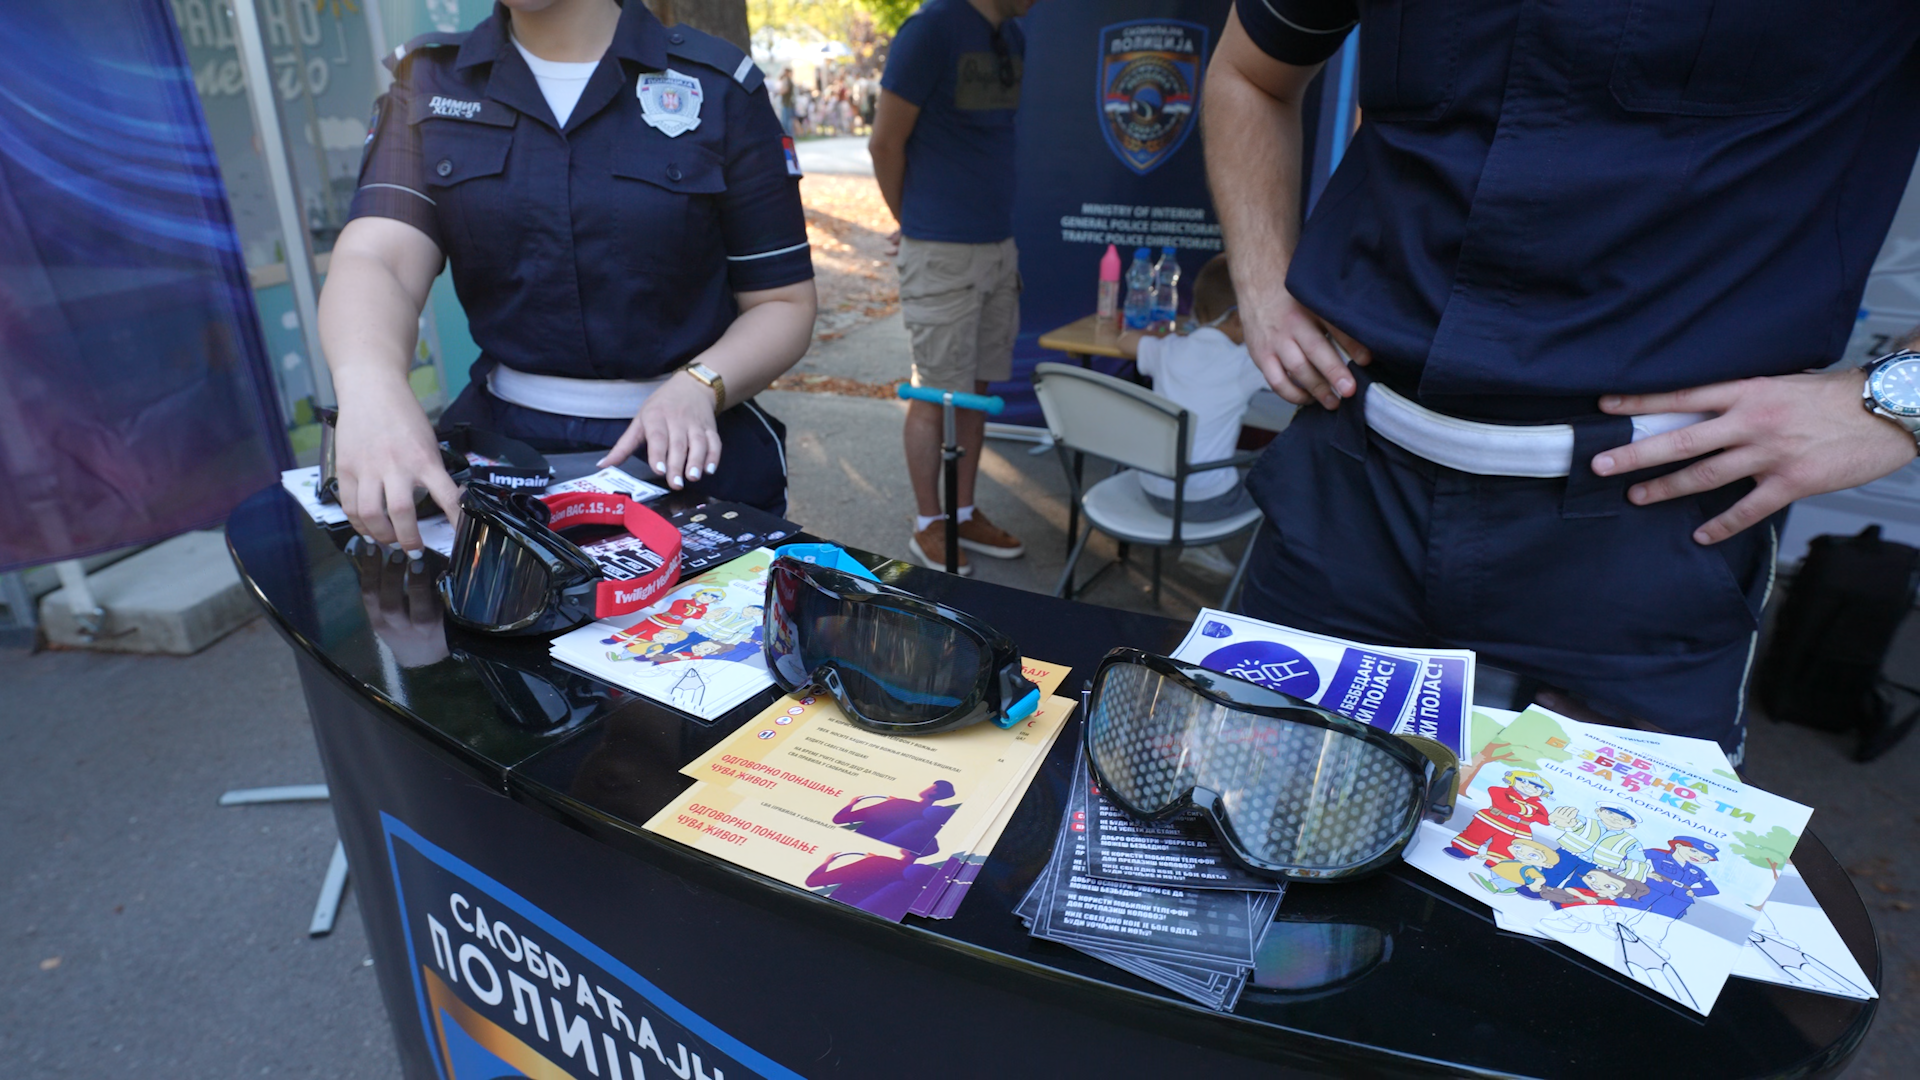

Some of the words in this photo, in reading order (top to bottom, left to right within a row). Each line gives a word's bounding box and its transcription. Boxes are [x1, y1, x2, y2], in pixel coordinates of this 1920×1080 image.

[1110, 37, 1194, 53] ПОЛИЦИЈА
[1081, 203, 1133, 217] MINISTRY
[1133, 205, 1150, 218] OF
[1151, 207, 1206, 221] INTERIOR
[1060, 215, 1108, 231] GENERAL
[1109, 218, 1149, 233] POLICE
[1061, 229, 1104, 243] TRAFFIC
[1105, 232, 1144, 247] POLICE
[1145, 235, 1222, 251] DIRECTORATE
[566, 503, 584, 518] BAC
[614, 580, 656, 604] Twilight
[1340, 654, 1377, 711] БЕЗБЕДАН!
[1361, 660, 1397, 710] ПОЈАС!
[1420, 663, 1444, 719] ПОЈАС!
[830, 731, 849, 740] НОСИТЕ
[849, 737, 868, 746] КАЦИГУ
[798, 754, 821, 765] ПРАВИЛА
[801, 748, 819, 757] ВРЕМЕ
[1583, 733, 1617, 748] ЗАЈЕДНО
[1624, 748, 1665, 766] БЕЗБЕДНО
[1665, 763, 1686, 774] КРОЗ
[1686, 771, 1739, 794] ДЕТИЊСТВО
[711, 763, 735, 777] ЧУВА
[735, 771, 778, 790] ЖИВОТ!
[721, 754, 781, 777] ОДГОВОРНО
[780, 770, 844, 798] ПОНАШАЊЕ
[1577, 760, 1613, 782] ЗА
[1544, 762, 1573, 778] ШТА
[1571, 774, 1614, 795] РАДИ
[1616, 791, 1728, 839] САОБРАЋАЈАЦ?
[677, 814, 705, 831] ЧУВА
[702, 823, 749, 847] ЖИВОТ!
[688, 803, 752, 831] ОДГОВОРНО
[750, 824, 819, 855] ПОНАШАЊЕ
[1101, 834, 1125, 842] ДОБРО
[1125, 836, 1159, 844] ОСМОТРИ
[1111, 852, 1144, 860] КОРИСТИ
[1181, 857, 1216, 865] ТЕЛЕФОН
[1069, 882, 1099, 892] МОЖЕШ
[1100, 887, 1142, 898] БЕЗБЕДНО!
[1071, 876, 1096, 885] ДОБРО
[1172, 890, 1184, 898] ДА
[1066, 900, 1083, 908] ДОК
[1084, 902, 1126, 915] ПРЕЛАЗИШ
[1127, 909, 1166, 920] КОЛОВОЗ!
[1067, 893, 1077, 901] НЕ
[1078, 895, 1112, 906] КОРИСТИ
[1113, 900, 1151, 911] МОБИЛНИ
[1152, 906, 1189, 917] ТЕЛЕФОН
[1063, 917, 1085, 927] БУДИ
[1086, 920, 1120, 932] УОЧЉИВ
[1064, 910, 1083, 918] НИЈЕ
[1083, 913, 1122, 925] СВЕЈЕДНО
[1123, 919, 1141, 928] КОЈЕ
[1142, 921, 1150, 929] ЈЕ
[1150, 923, 1169, 932] БОЈЕ
[1169, 926, 1198, 936] ОДЕЋА
